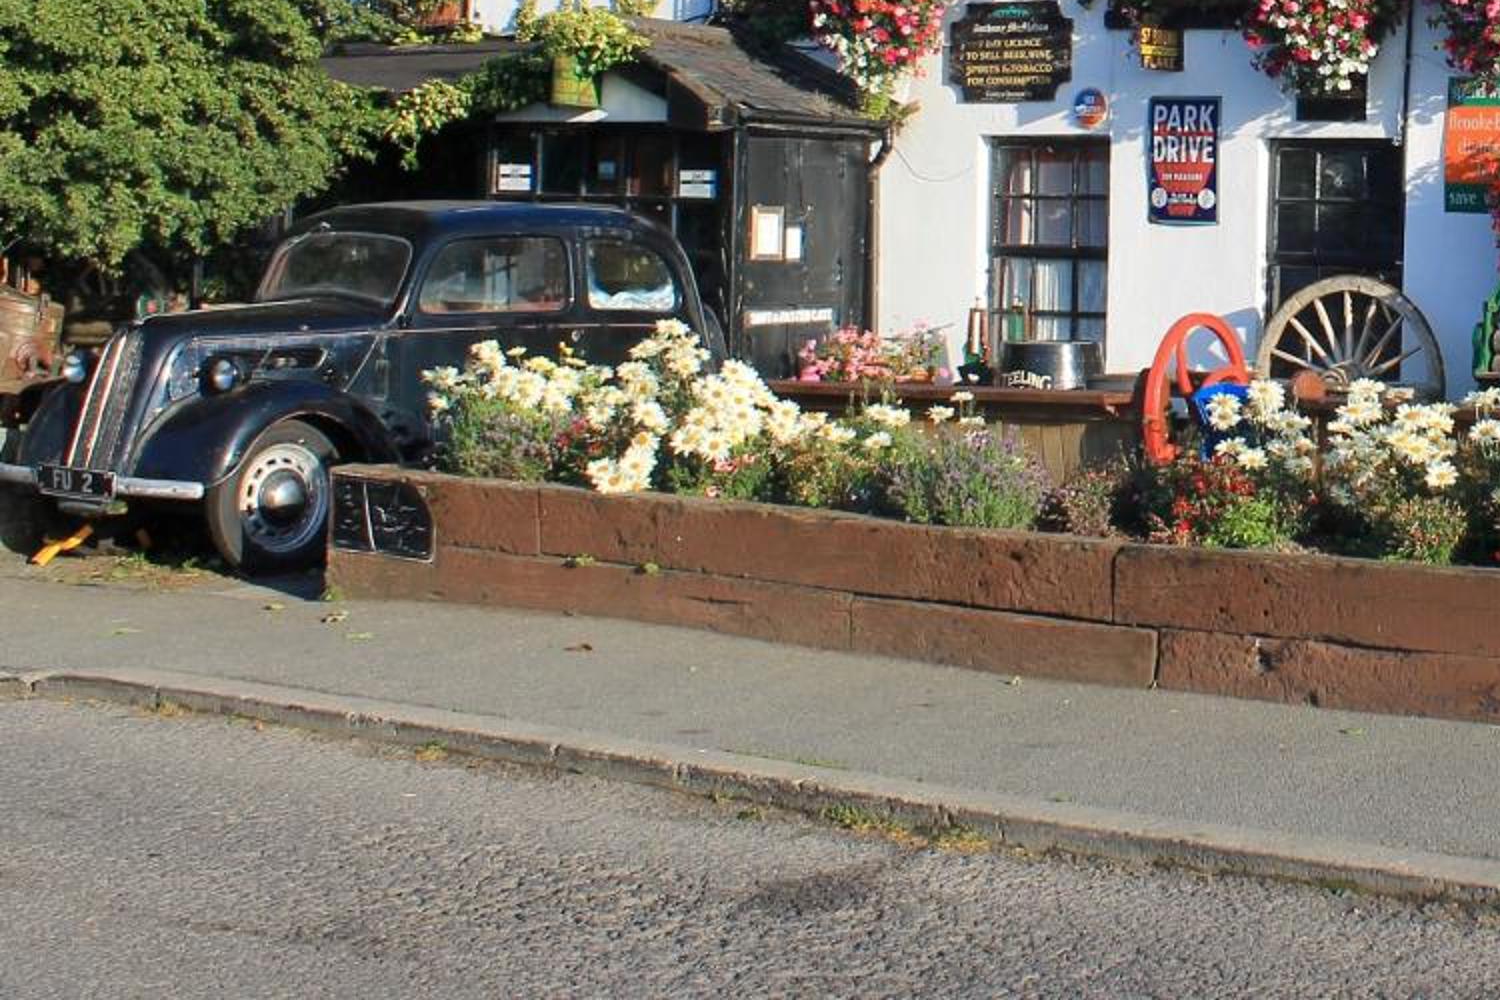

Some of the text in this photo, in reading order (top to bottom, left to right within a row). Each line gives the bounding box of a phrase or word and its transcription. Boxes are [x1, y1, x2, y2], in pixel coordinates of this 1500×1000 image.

[966, 51, 978, 60] TO
[980, 50, 999, 60] SELL
[1009, 63, 1053, 73] TOBACCO
[967, 77, 984, 87] FOR
[1153, 103, 1215, 132] PARK
[1153, 134, 1215, 163] DRIVE
[82, 473, 93, 493] 2
